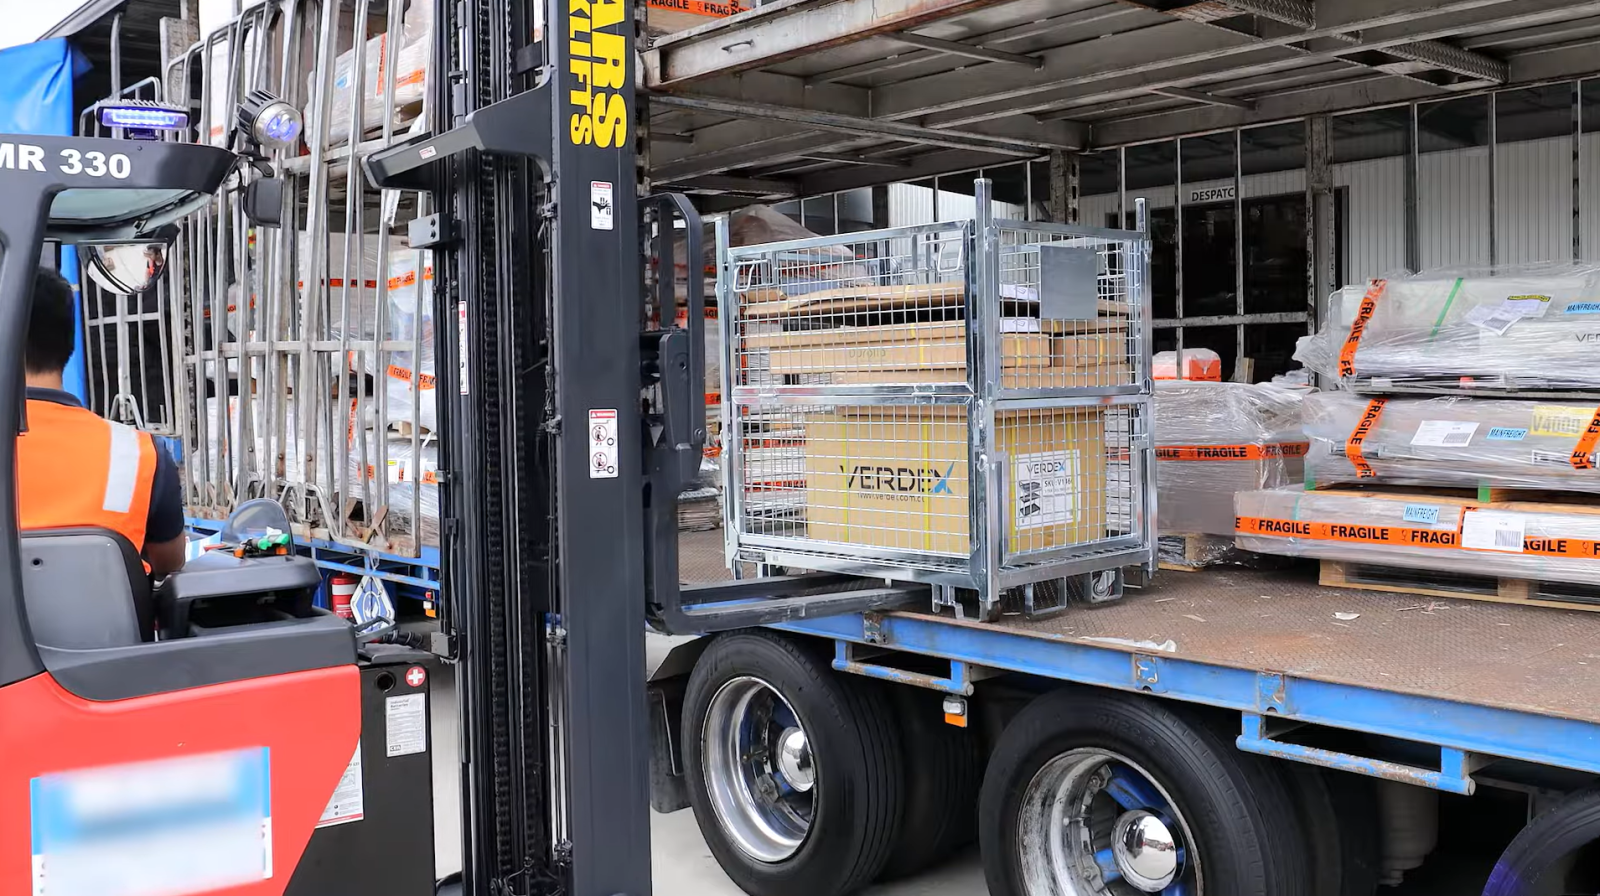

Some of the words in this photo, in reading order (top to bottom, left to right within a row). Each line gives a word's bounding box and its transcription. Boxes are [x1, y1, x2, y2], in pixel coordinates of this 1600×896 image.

[60, 148, 131, 179] 330
[1350, 400, 1385, 444] FRAGILE
[1197, 447, 1247, 458] FRAGILE
[1266, 444, 1301, 456] FRAGILE
[838, 458, 955, 494] VERDEX
[1026, 461, 1066, 475] VERDEX
[1258, 520, 1311, 535] FRAGILE
[1331, 526, 1389, 541] FRAGILE
[1411, 531, 1455, 545] FRAGI
